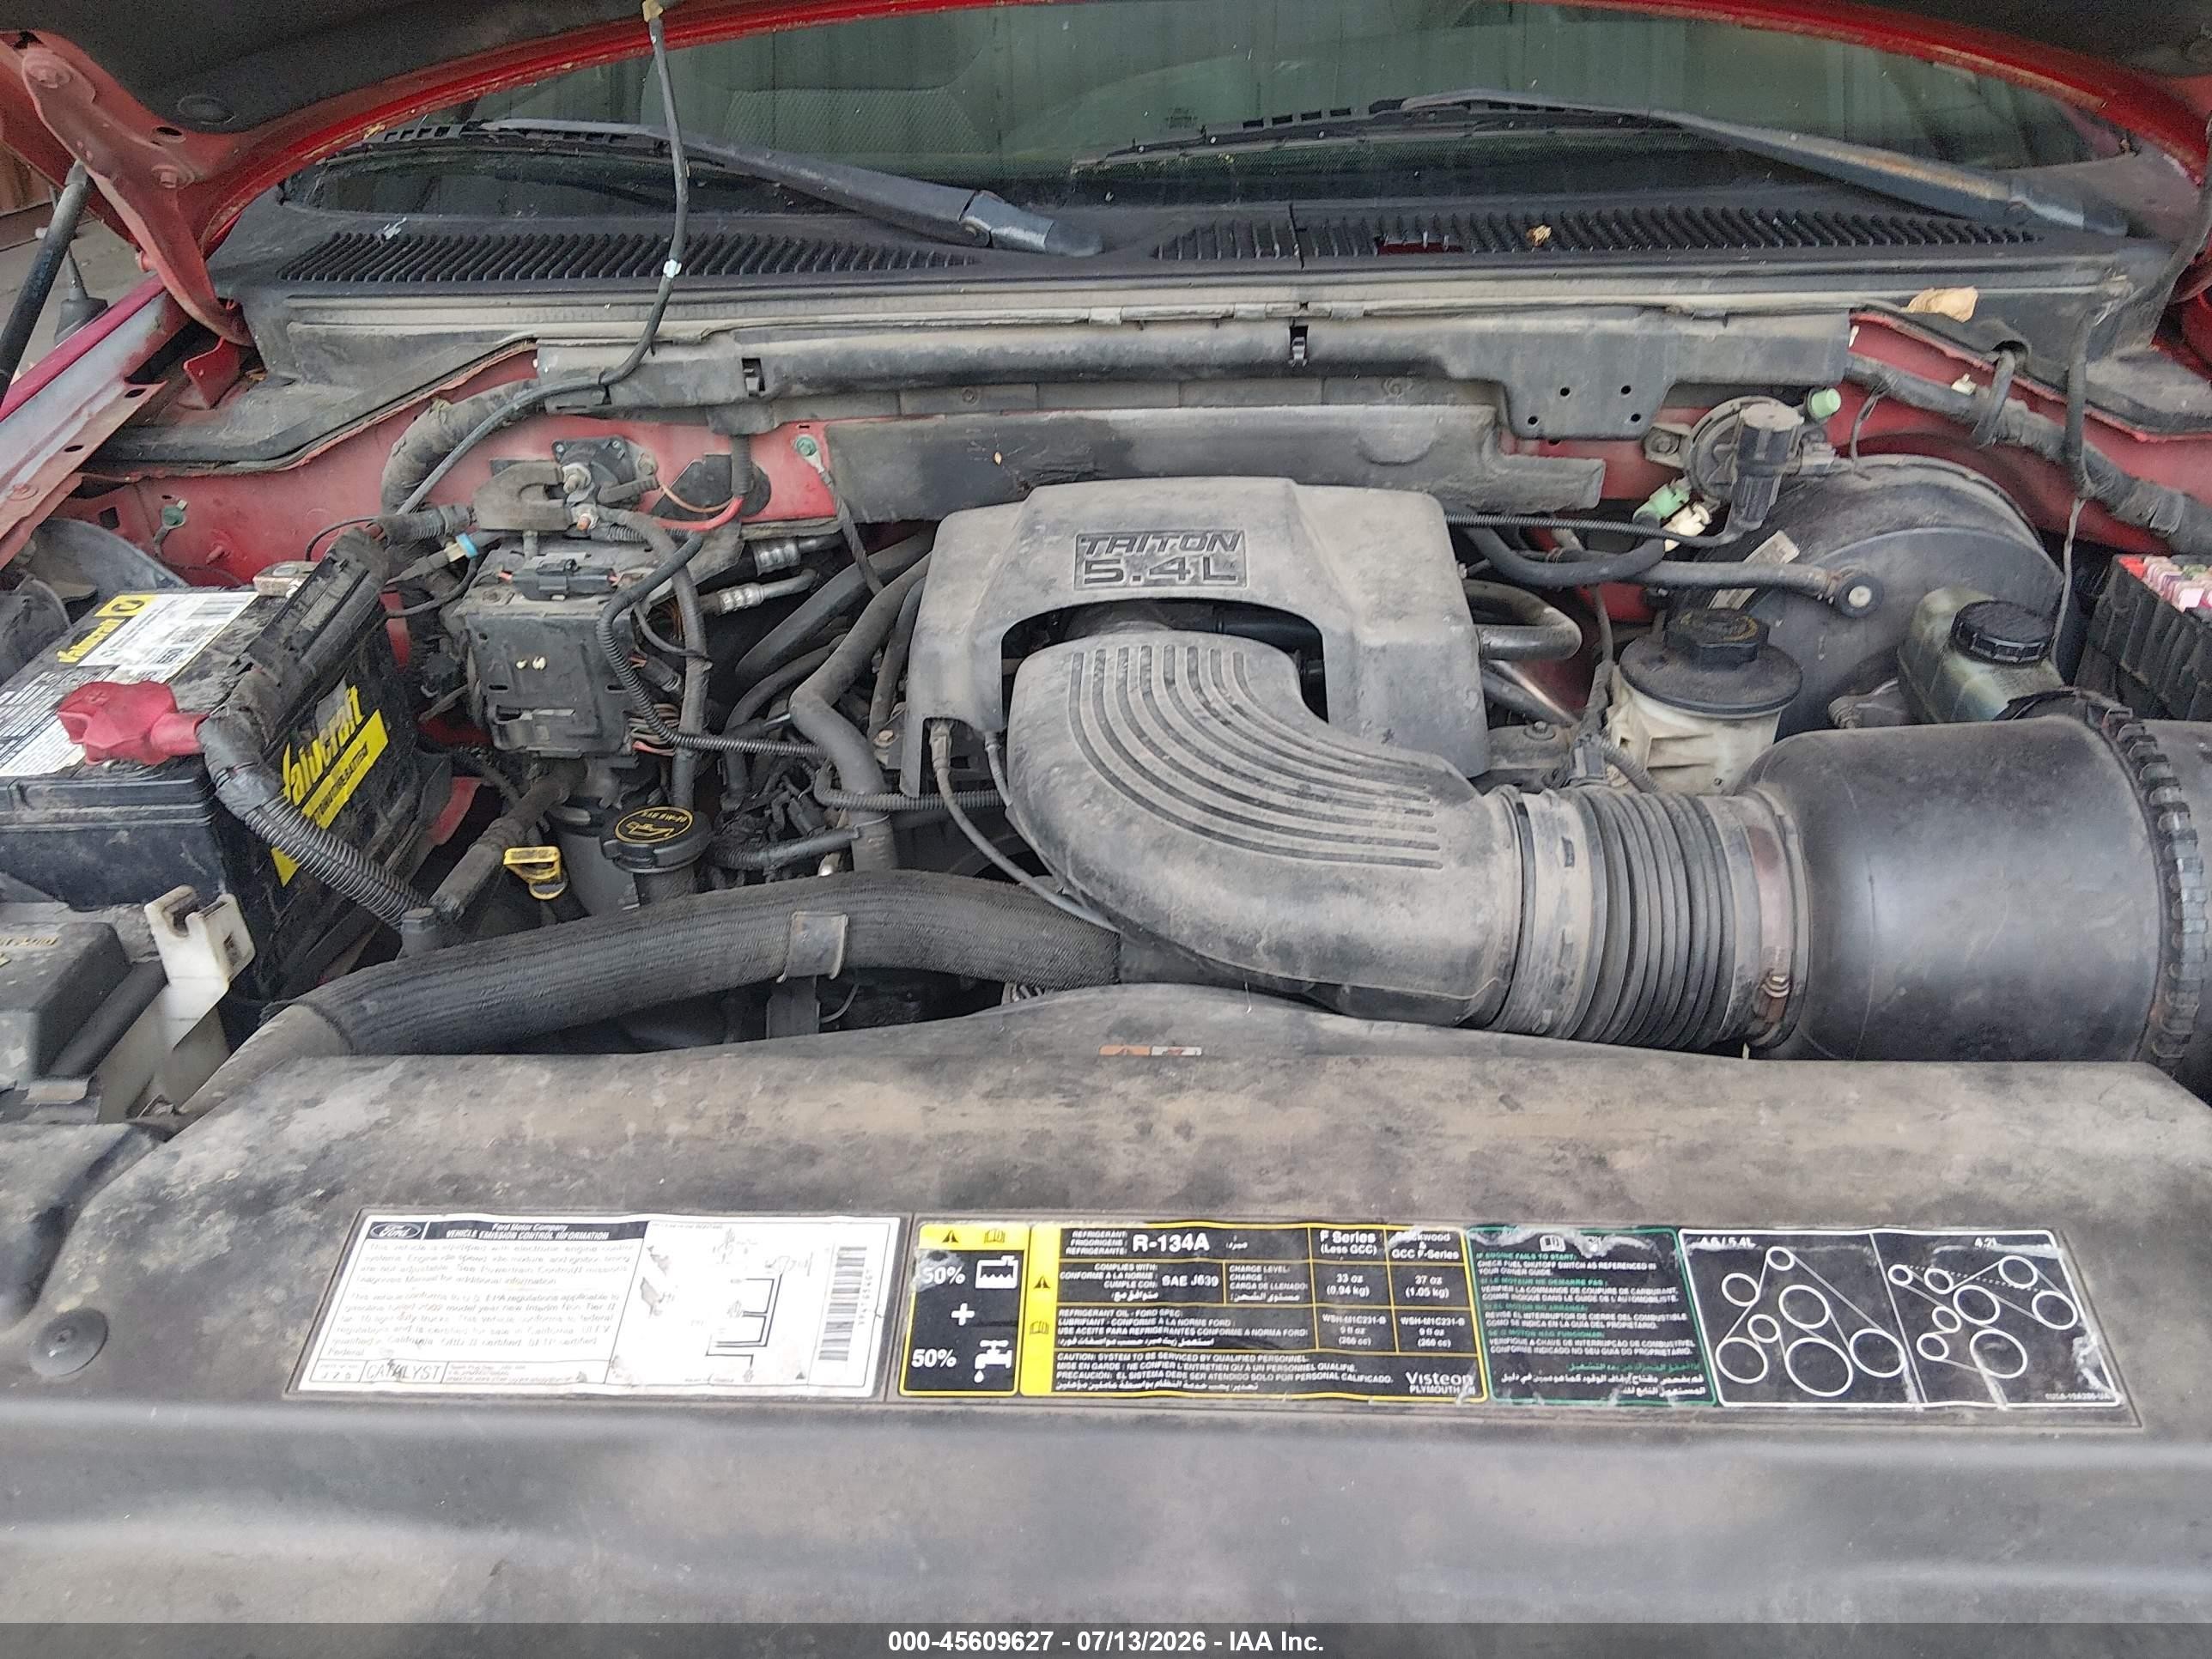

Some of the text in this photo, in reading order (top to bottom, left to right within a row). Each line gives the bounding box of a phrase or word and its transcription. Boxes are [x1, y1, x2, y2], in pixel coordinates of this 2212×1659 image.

[1081, 534, 1241, 556] TRITON
[1084, 556, 1237, 585] 5.4L
[379, 1224, 413, 1237] Ford
[1332, 1231, 1376, 1243] Series
[1133, 1232, 1210, 1253] R-134A
[921, 1266, 966, 1285] 50%
[1162, 1275, 1219, 1287] SAE J639
[911, 1348, 957, 1369] 50%
[1405, 1371, 1474, 1386] Visteon
